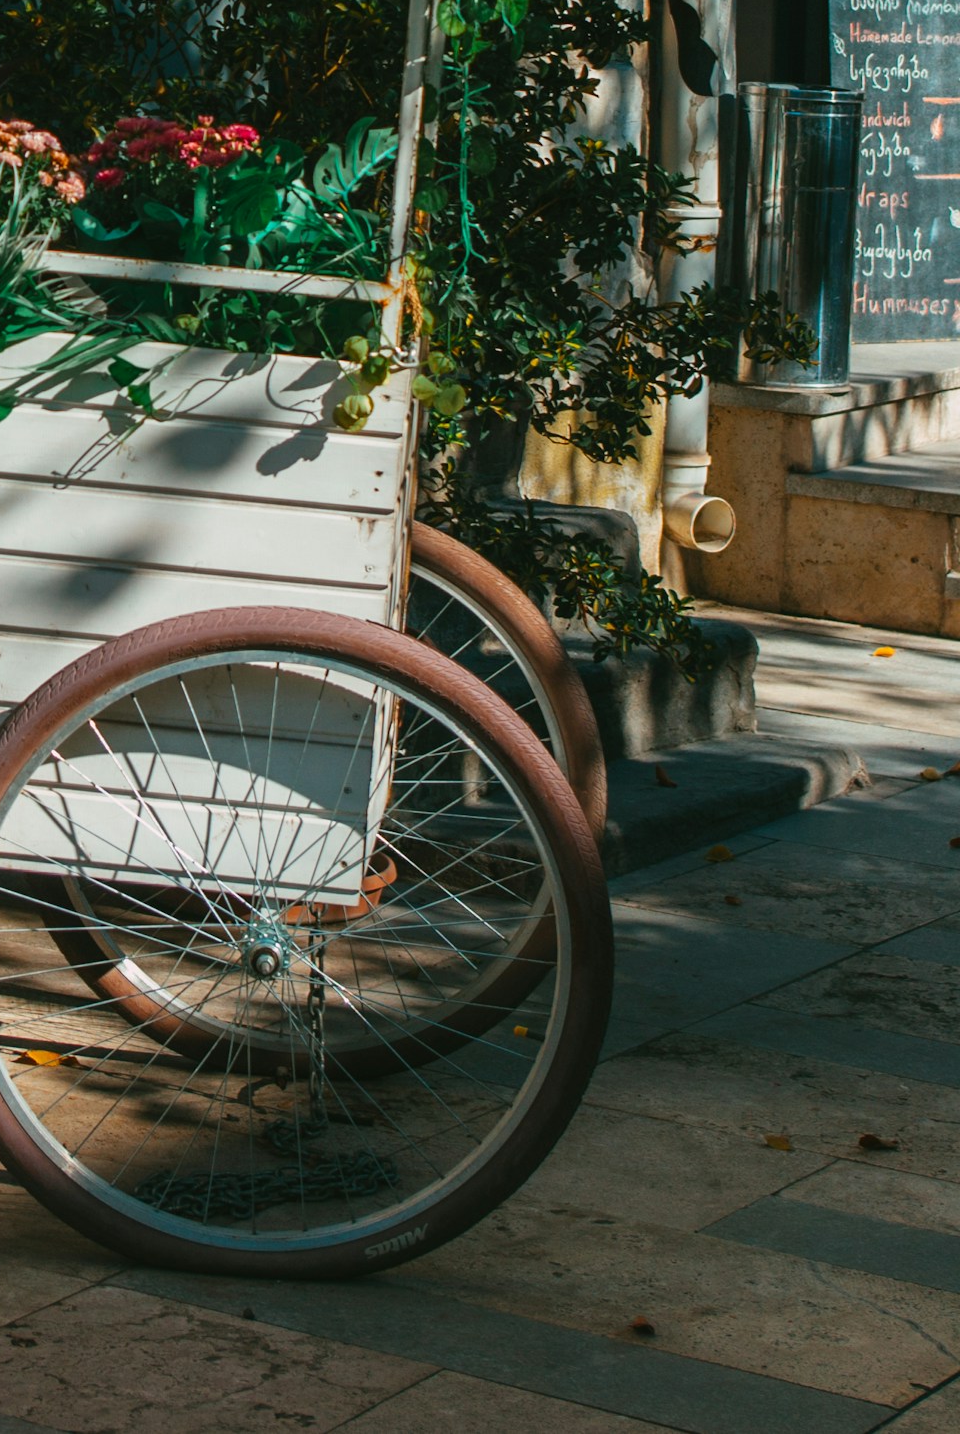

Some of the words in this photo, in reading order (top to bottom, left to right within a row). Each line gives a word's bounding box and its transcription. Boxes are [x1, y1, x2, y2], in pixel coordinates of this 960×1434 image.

[850, 21, 913, 44] Homemade
[861, 101, 911, 127] andwich
[853, 280, 950, 316] Hummuses
